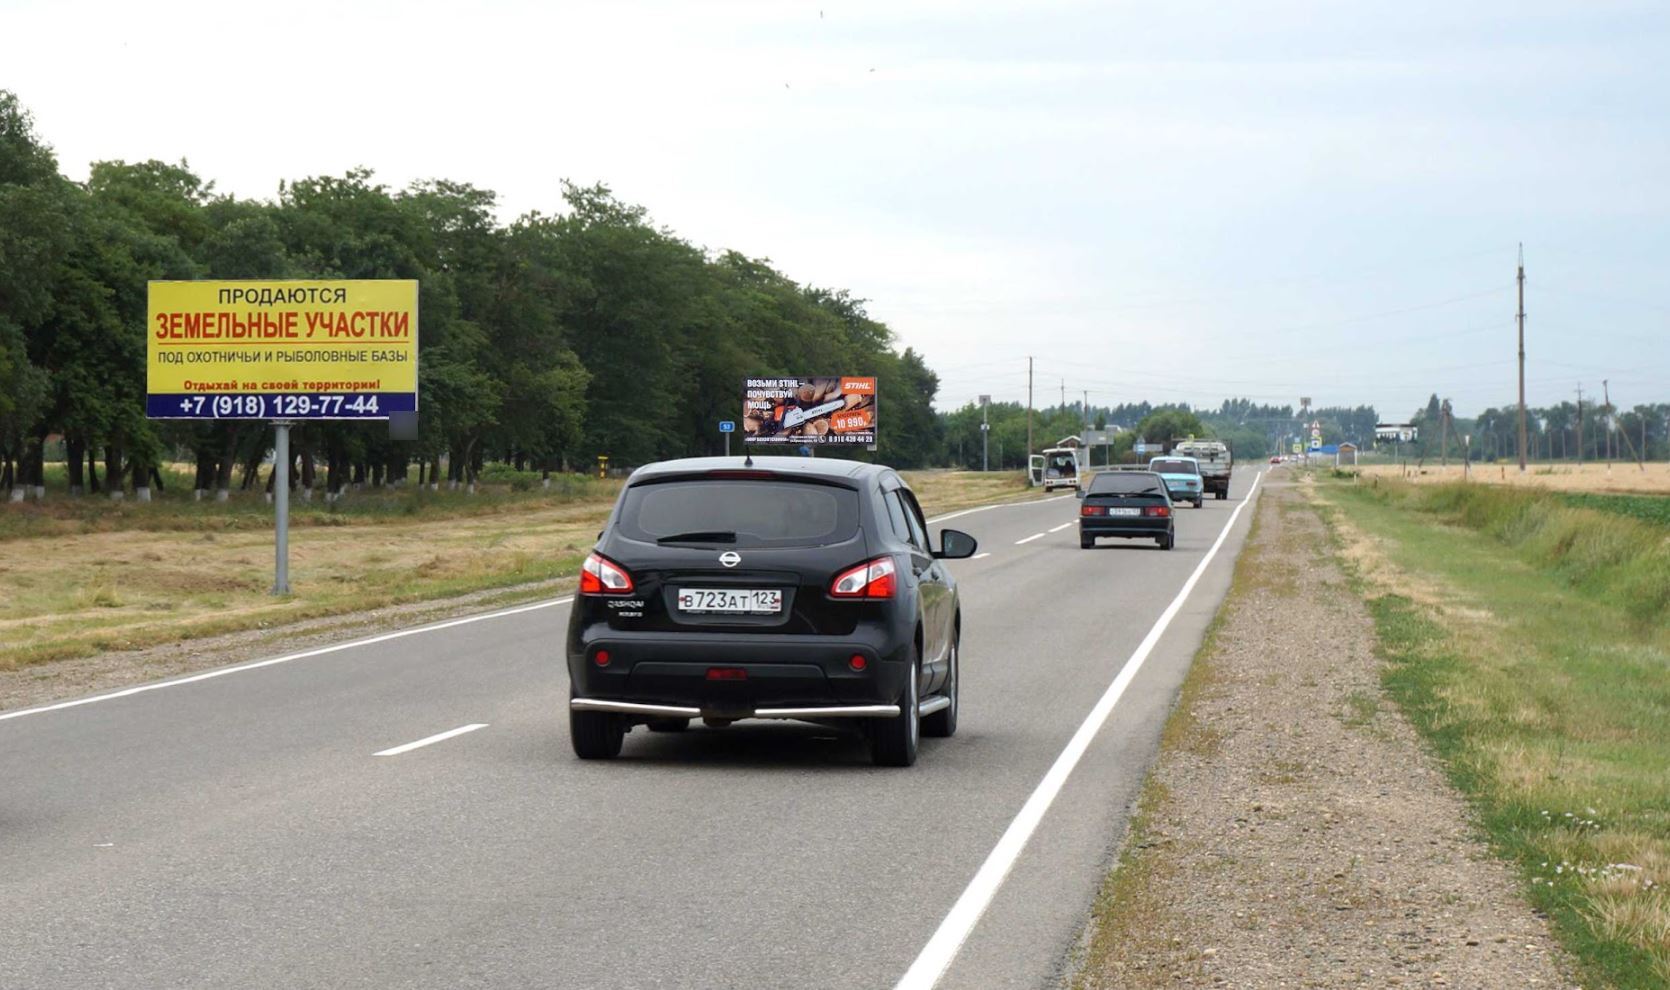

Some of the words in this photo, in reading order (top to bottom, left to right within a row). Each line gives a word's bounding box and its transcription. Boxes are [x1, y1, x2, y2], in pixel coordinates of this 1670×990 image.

[219, 288, 347, 306] ПРОДАЮТСЯ
[156, 312, 298, 339] ЗЕМЕЛЬНЫЕ
[306, 311, 409, 338] УЧАСТКИ
[158, 351, 184, 365] ПОД
[187, 351, 261, 363] ОХОТНИЧЬИ
[265, 351, 273, 362] И
[276, 350, 368, 362] РЫБОЛОВНЫЕ
[371, 350, 408, 362] БАЗЫ
[184, 380, 238, 391] Отдыхай
[243, 382, 257, 390] на
[261, 380, 299, 390] своей
[303, 379, 380, 391] территории!
[747, 380, 778, 388] ВОЗЬМИ
[778, 380, 799, 388] STIHL
[844, 382, 871, 390] STIHL
[747, 389, 793, 398] ПОЧУВСТВУЙ
[180, 396, 205, 414] +7
[212, 396, 265, 418] (918)
[273, 396, 379, 414] 129-77-44
[747, 401, 772, 410] МОЩЬ
[753, 592, 777, 604] 123
